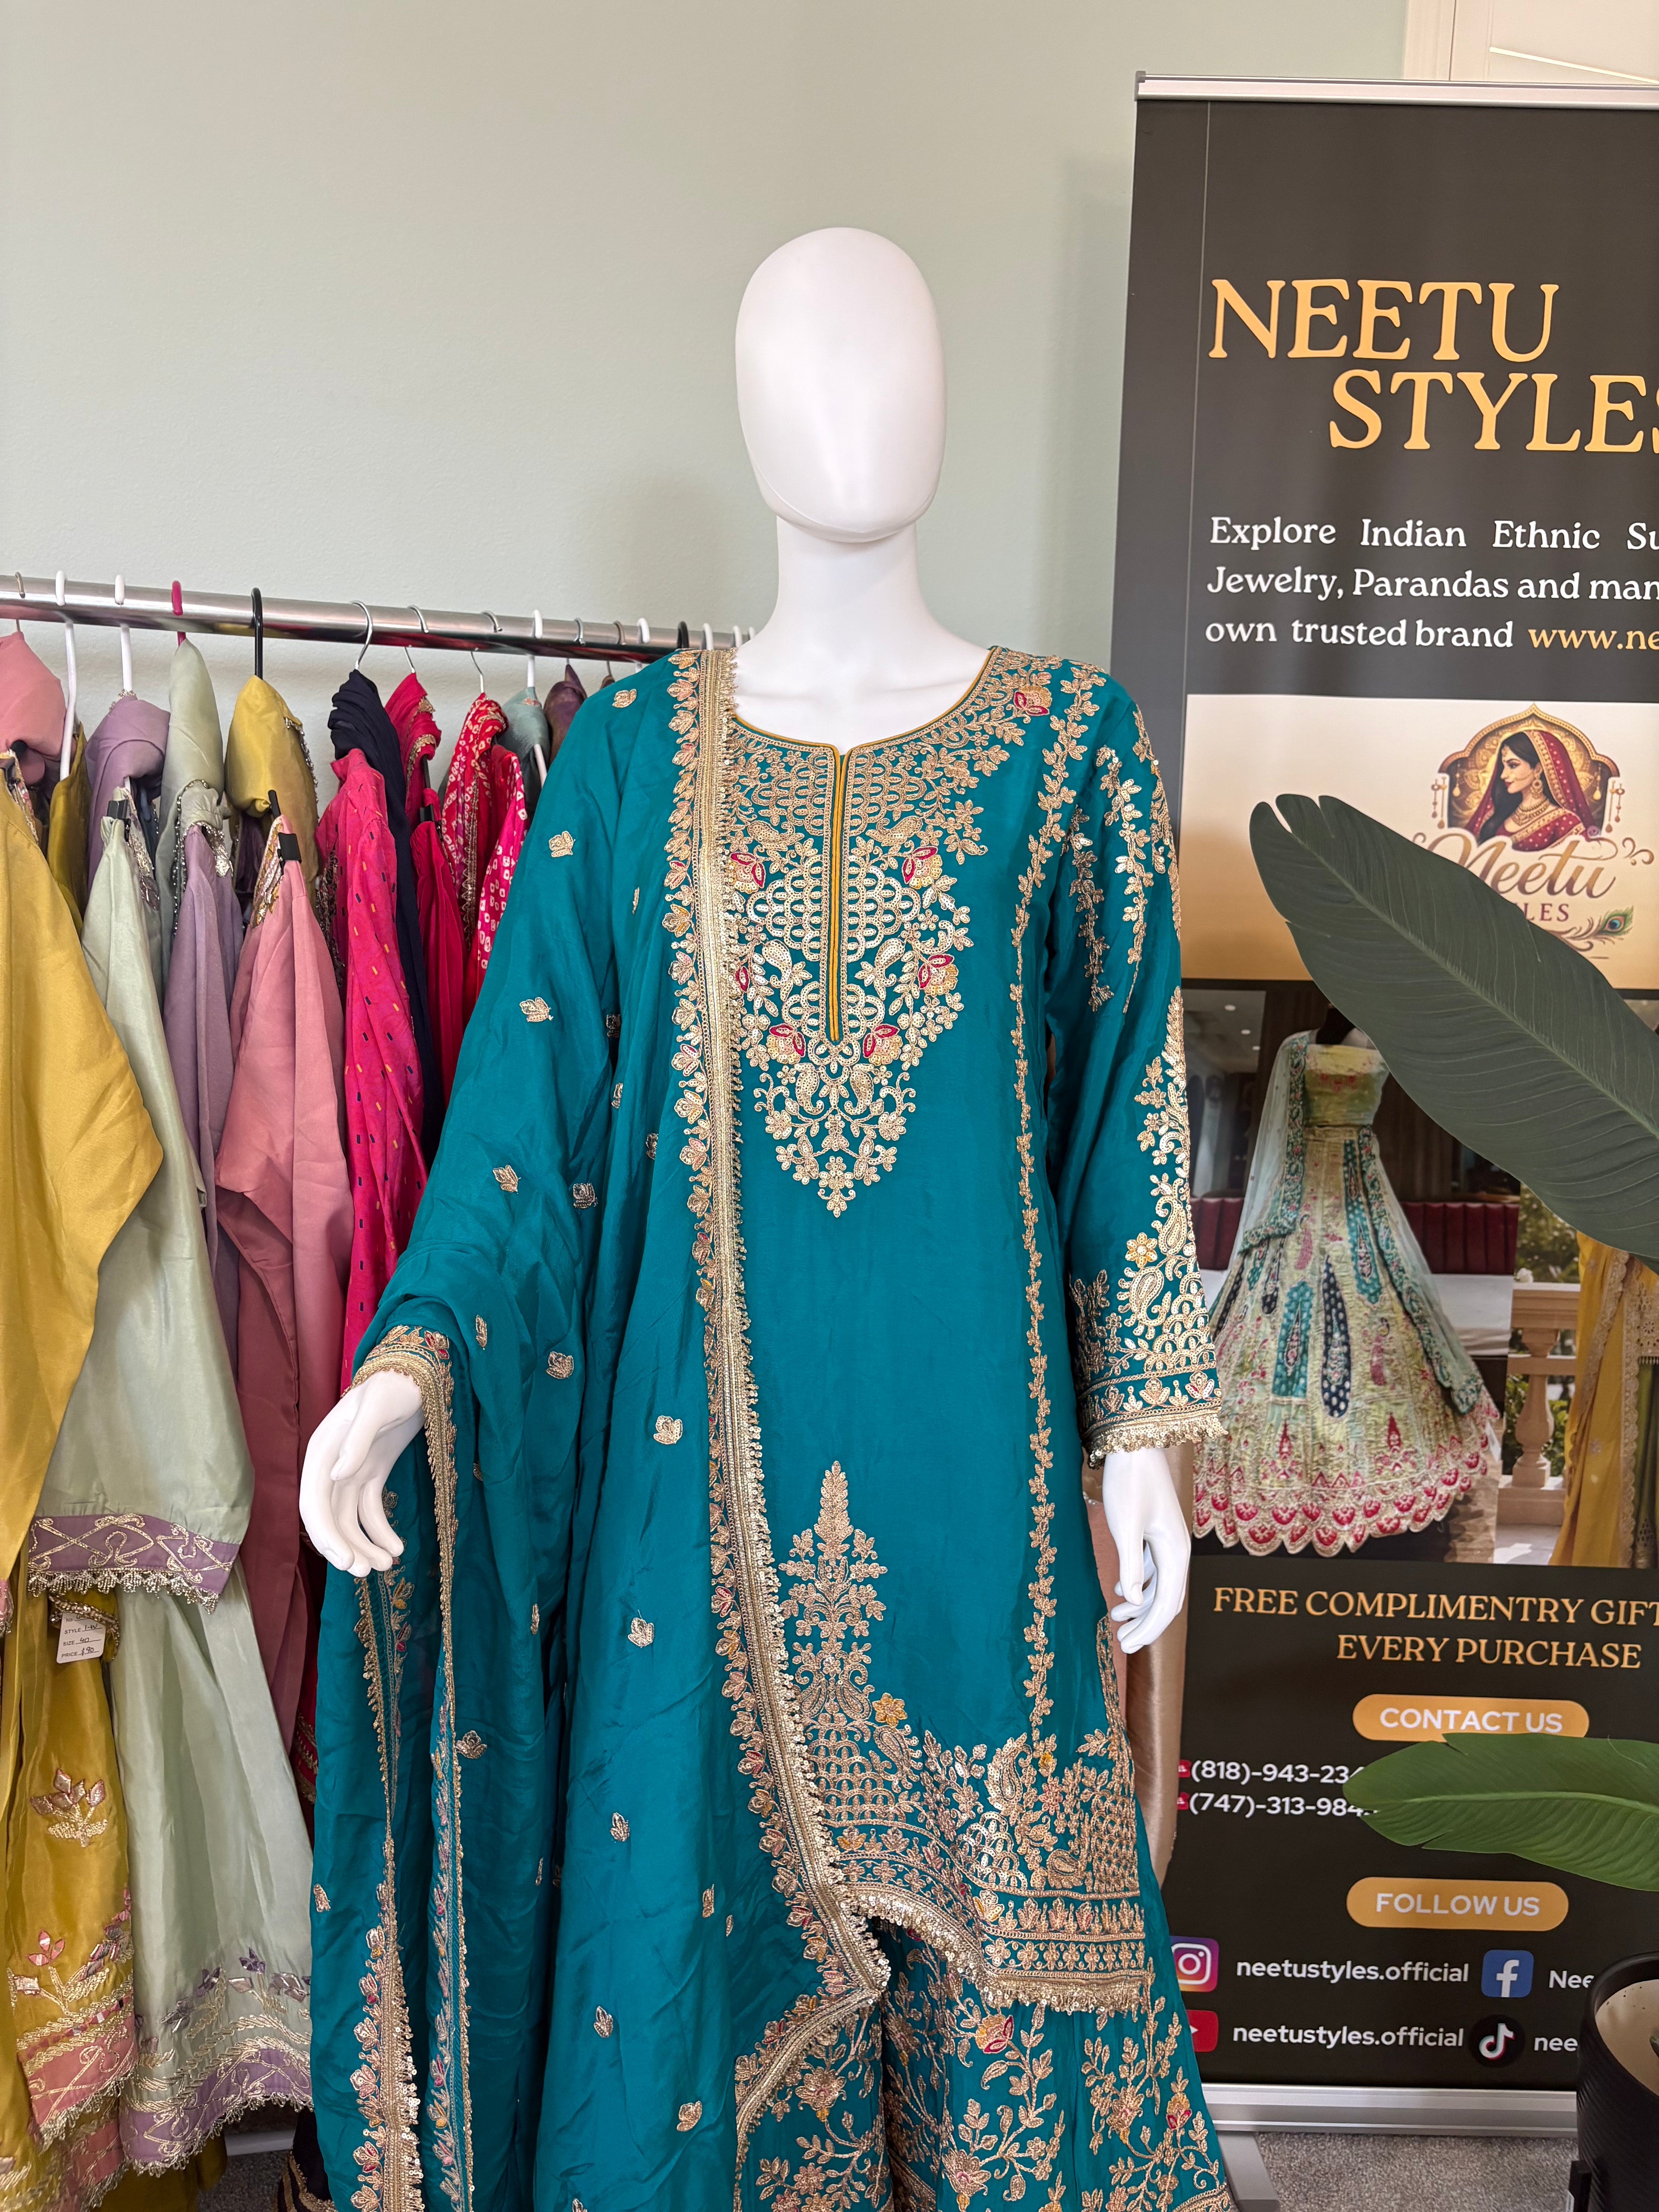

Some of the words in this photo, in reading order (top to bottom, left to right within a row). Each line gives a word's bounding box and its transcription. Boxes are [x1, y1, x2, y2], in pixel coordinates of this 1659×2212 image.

[1208, 279, 1559, 362] NEETU
[1329, 369, 1659, 454] STYLE
[1210, 516, 1336, 550] Explore
[1360, 518, 1467, 547] Indian
[1492, 520, 1600, 549] Ethnic
[1207, 566, 1344, 601] Jewelry,
[1352, 569, 1509, 598] Parandas
[1517, 572, 1580, 599] and
[1205, 622, 1278, 642] own
[1291, 619, 1407, 646] trusted
[1415, 619, 1513, 648] brand
[1214, 1587, 1298, 1615] FREE
[1306, 1591, 1584, 1623] COMPLIMENTRY
[1337, 1635, 1449, 1662] EVERY
[1456, 1638, 1641, 1668] PURCHASE
[1380, 1708, 1519, 1732] CONTACT
[1526, 1713, 1562, 1733] US
[1192, 1760, 1364, 1785] (818)-943-23
[1189, 1792, 1378, 1818] (747)-313-984
[1376, 1893, 1497, 1914] FOLLOW
[1504, 1897, 1539, 1916] US
[1237, 1960, 1468, 1983] neetustyles.official
[1233, 2025, 1463, 2049] neetustyles.official
